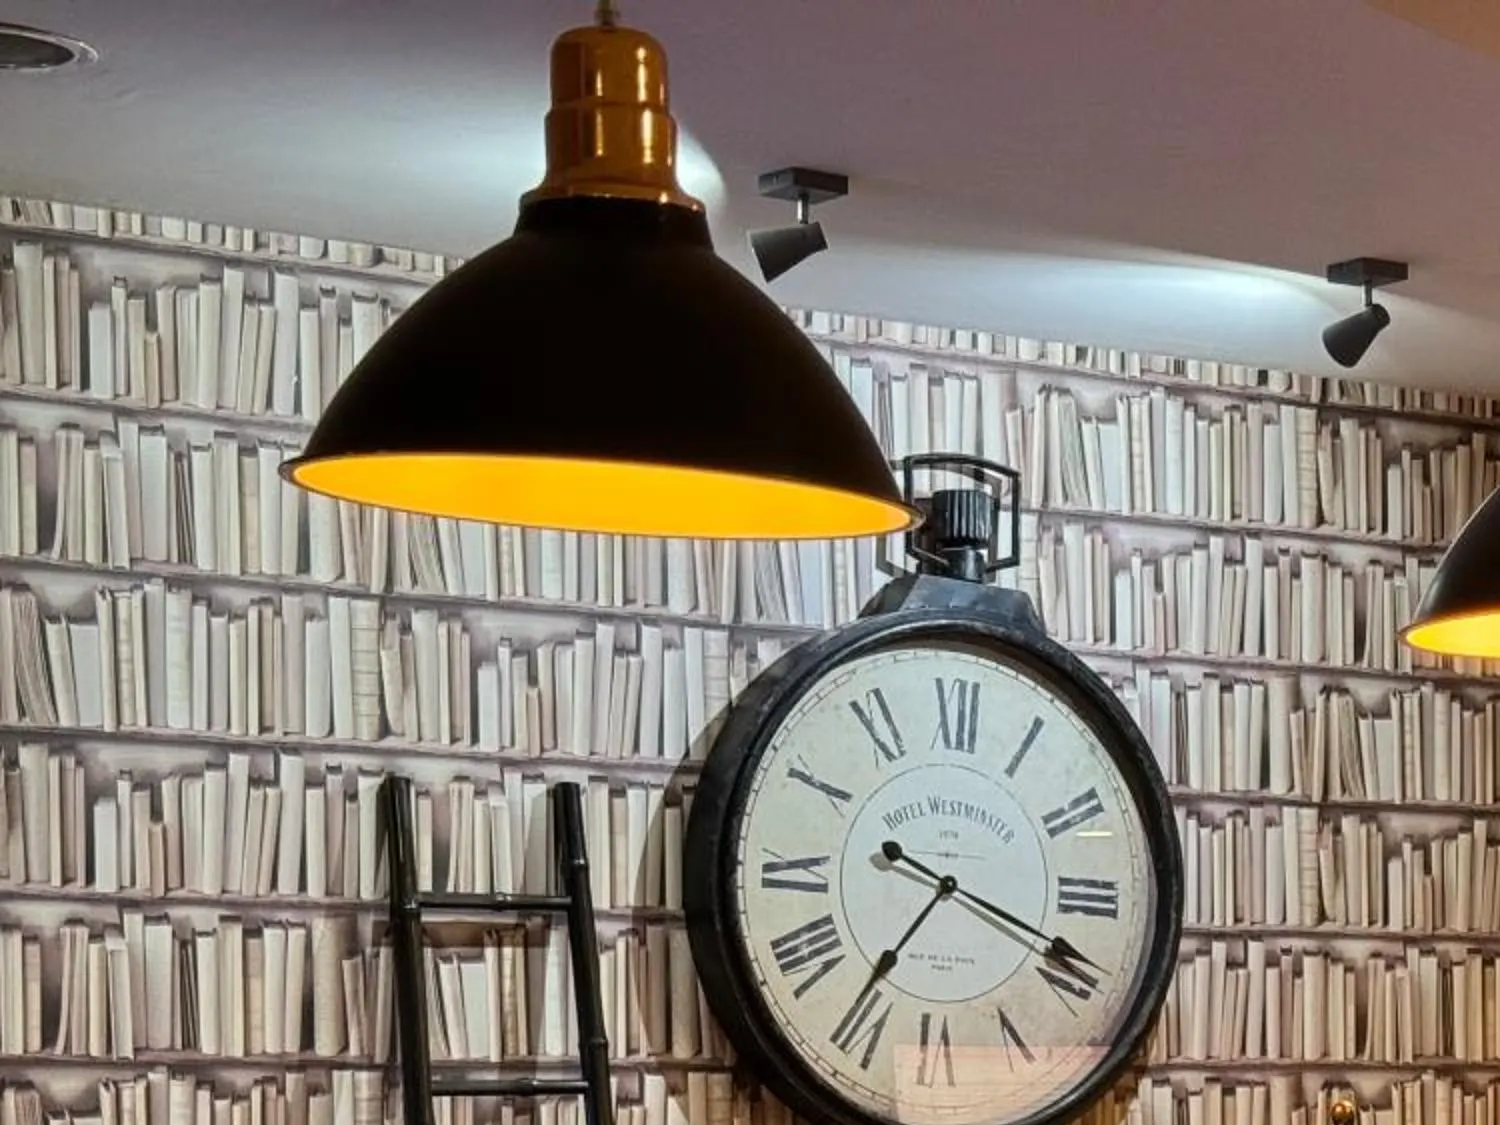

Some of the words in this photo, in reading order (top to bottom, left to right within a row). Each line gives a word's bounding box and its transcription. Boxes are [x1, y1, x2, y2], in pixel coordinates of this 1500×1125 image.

[849, 687, 906, 768] XI
[931, 677, 981, 755] XII
[881, 801, 927, 832] HOTEL
[1057, 876, 1120, 919] III
